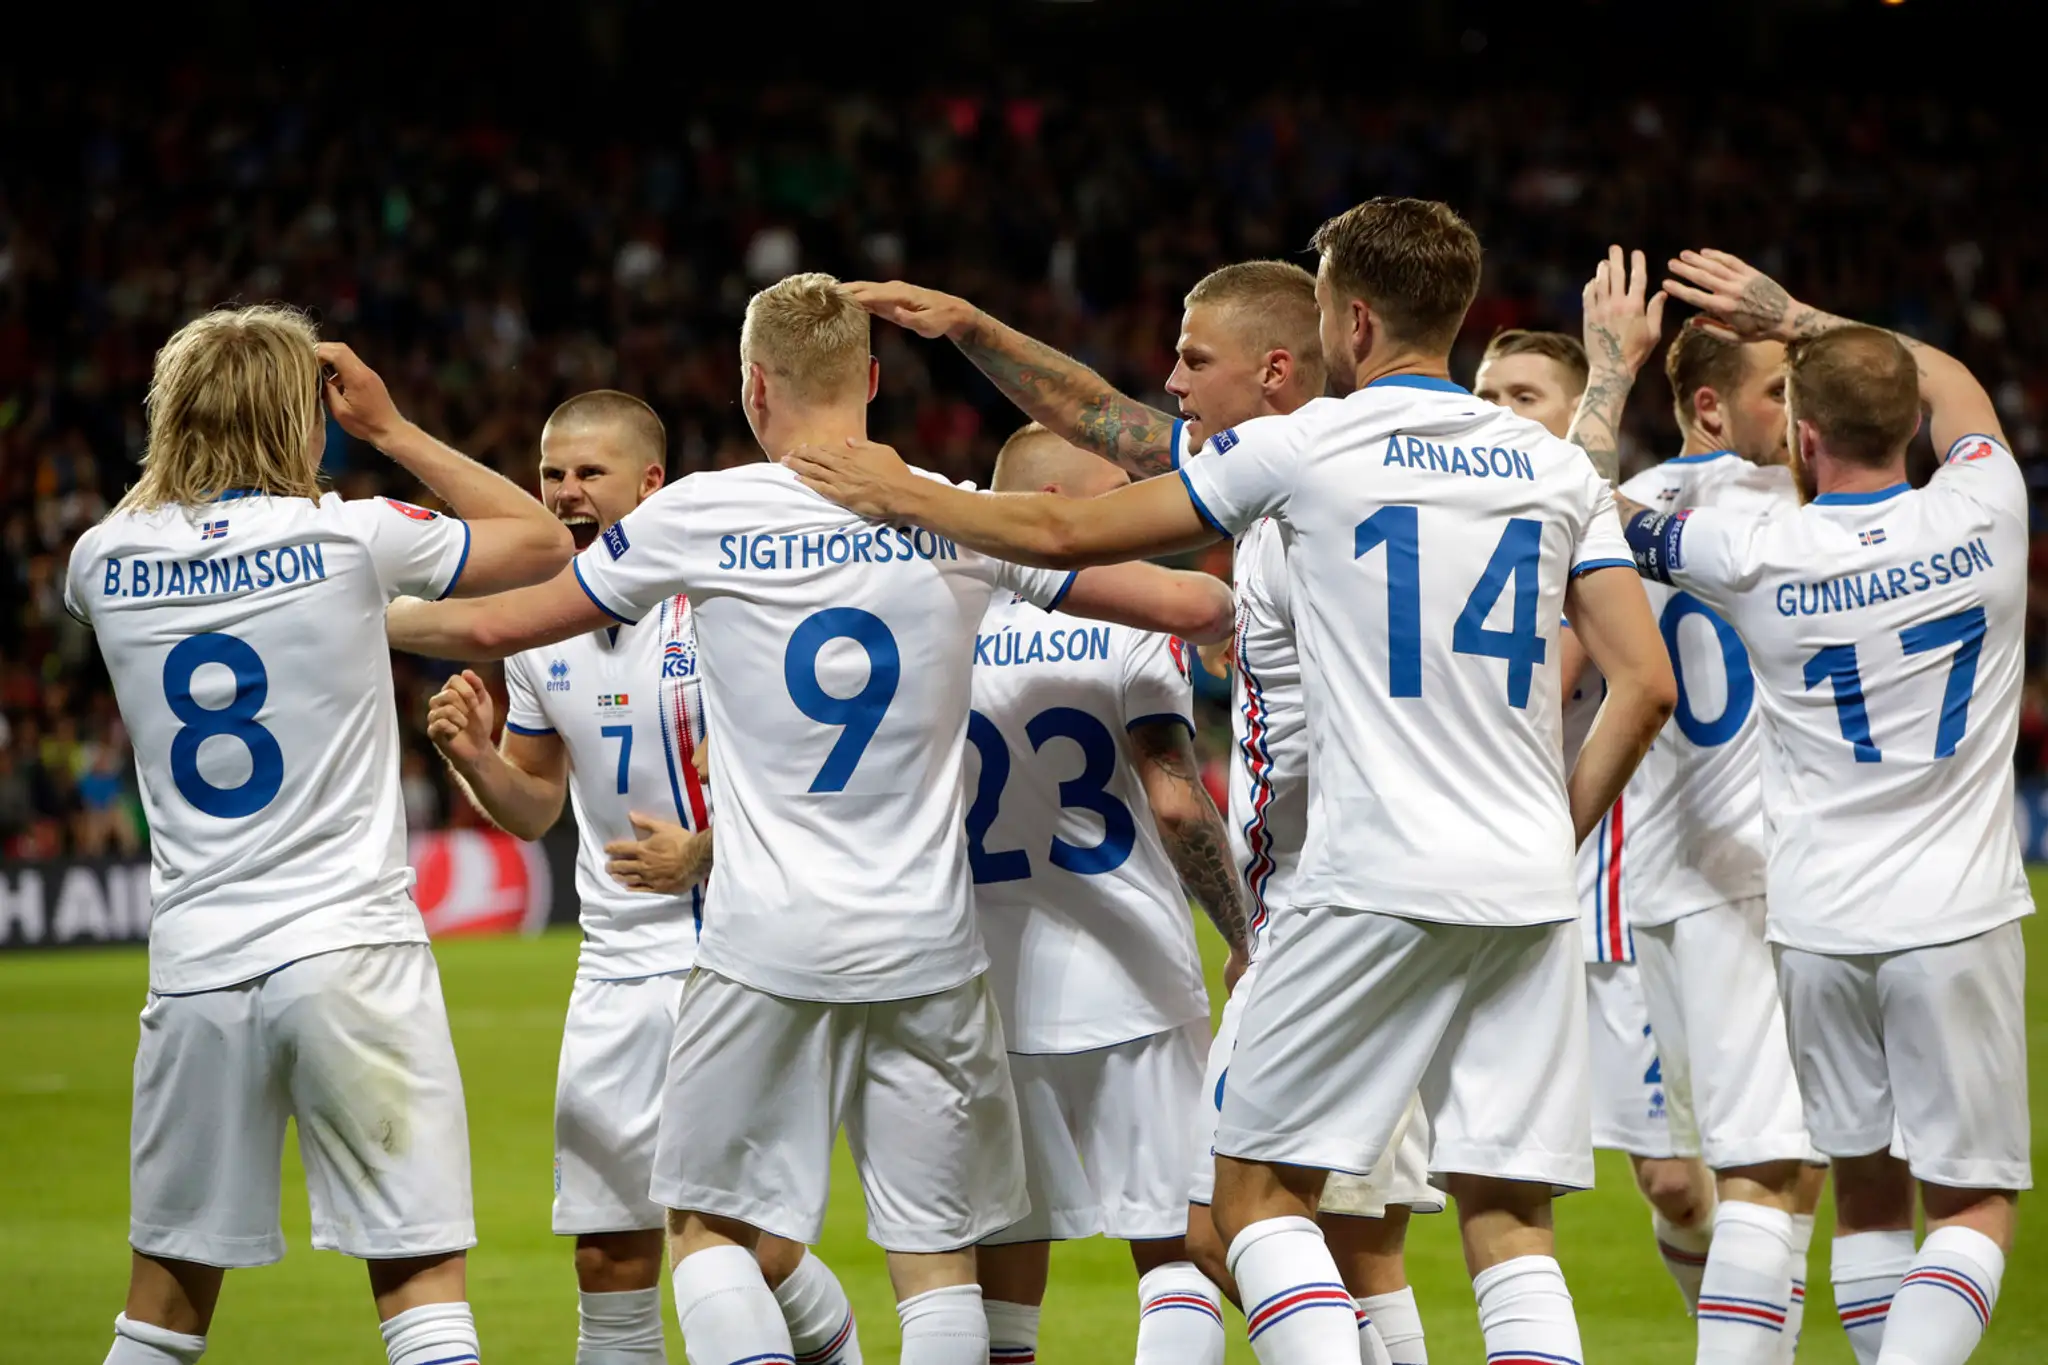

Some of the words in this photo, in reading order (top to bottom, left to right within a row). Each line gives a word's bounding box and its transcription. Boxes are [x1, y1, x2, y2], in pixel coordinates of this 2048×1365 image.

[104, 543, 327, 597] B.BJARNASON
[604, 525, 625, 555] SPECT
[718, 526, 958, 570] SIGTHÓRSSON
[1669, 521, 1682, 567] RESPECT
[1776, 537, 1994, 617] GUNNARSSON
[1354, 504, 1547, 710] 14
[973, 625, 1111, 667] KÚLASON
[784, 606, 901, 793] 9
[1802, 605, 1988, 763] 17
[162, 631, 285, 819] 8
[600, 724, 633, 795] 7
[964, 706, 1137, 885] 23
